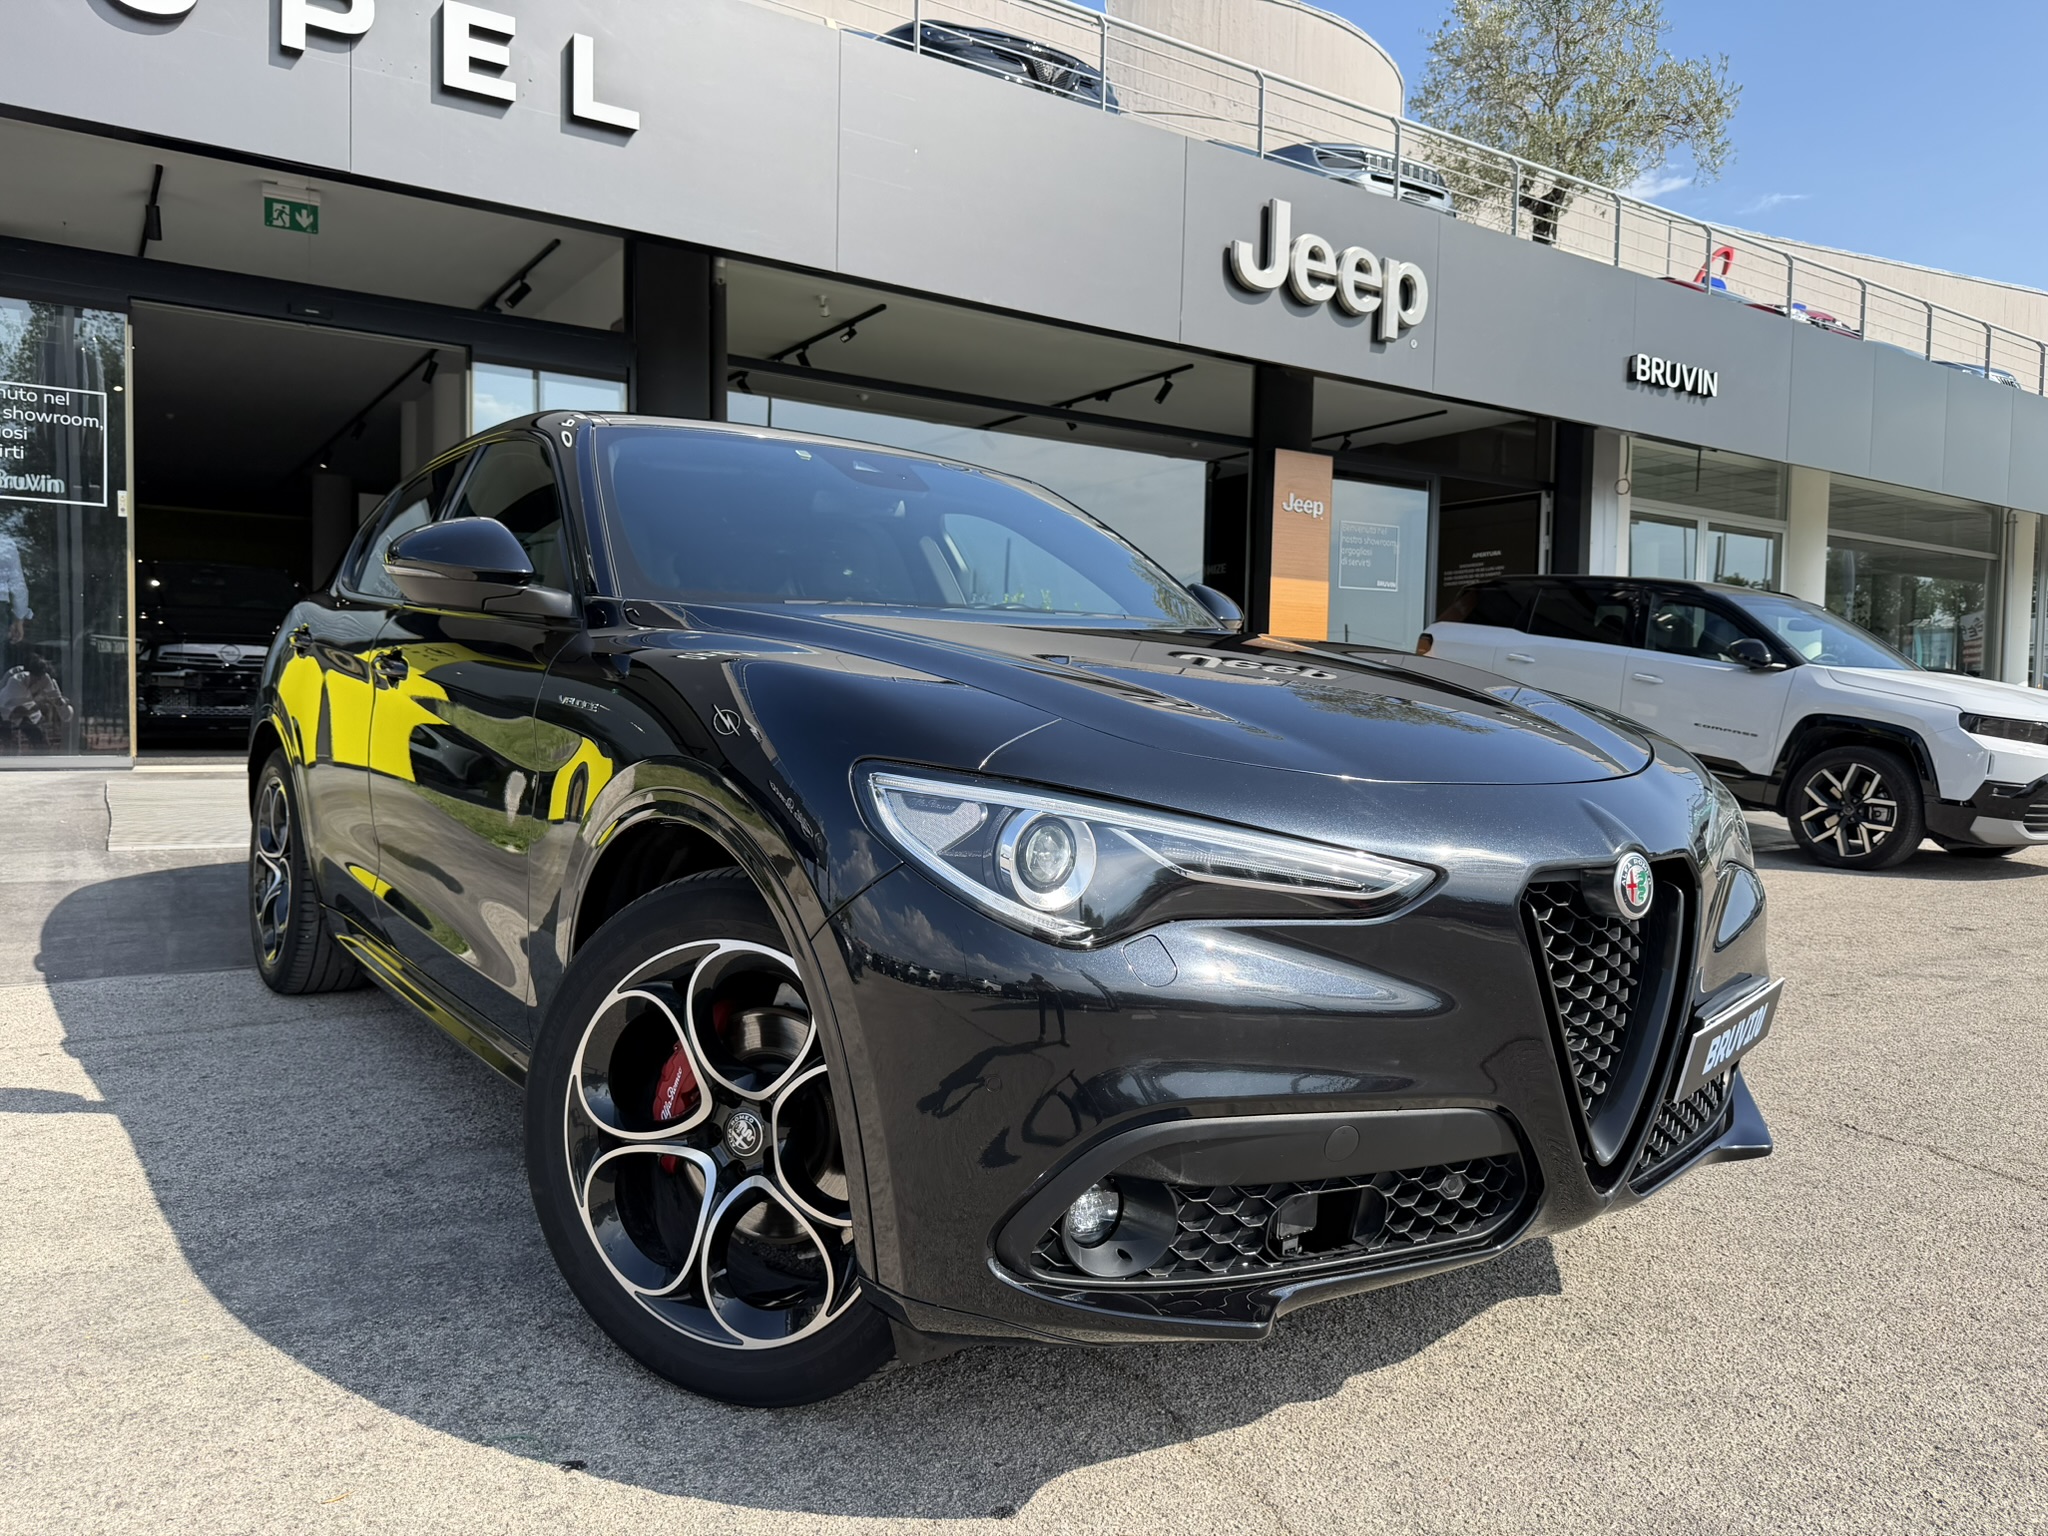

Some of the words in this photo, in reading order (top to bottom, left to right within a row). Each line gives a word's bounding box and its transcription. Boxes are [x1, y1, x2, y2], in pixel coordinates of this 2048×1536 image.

[108, 0, 640, 131] PEL
[1230, 197, 1429, 343] Jeep
[1635, 352, 1719, 398] BRUVIN
[44, 391, 70, 406] nel
[3, 405, 104, 431] showroom,
[1282, 492, 1324, 519] Jeep
[1693, 722, 1759, 738] COMPASS
[1701, 1002, 1769, 1075] BRUVIN
[730, 1114, 755, 1126] ROMEO
